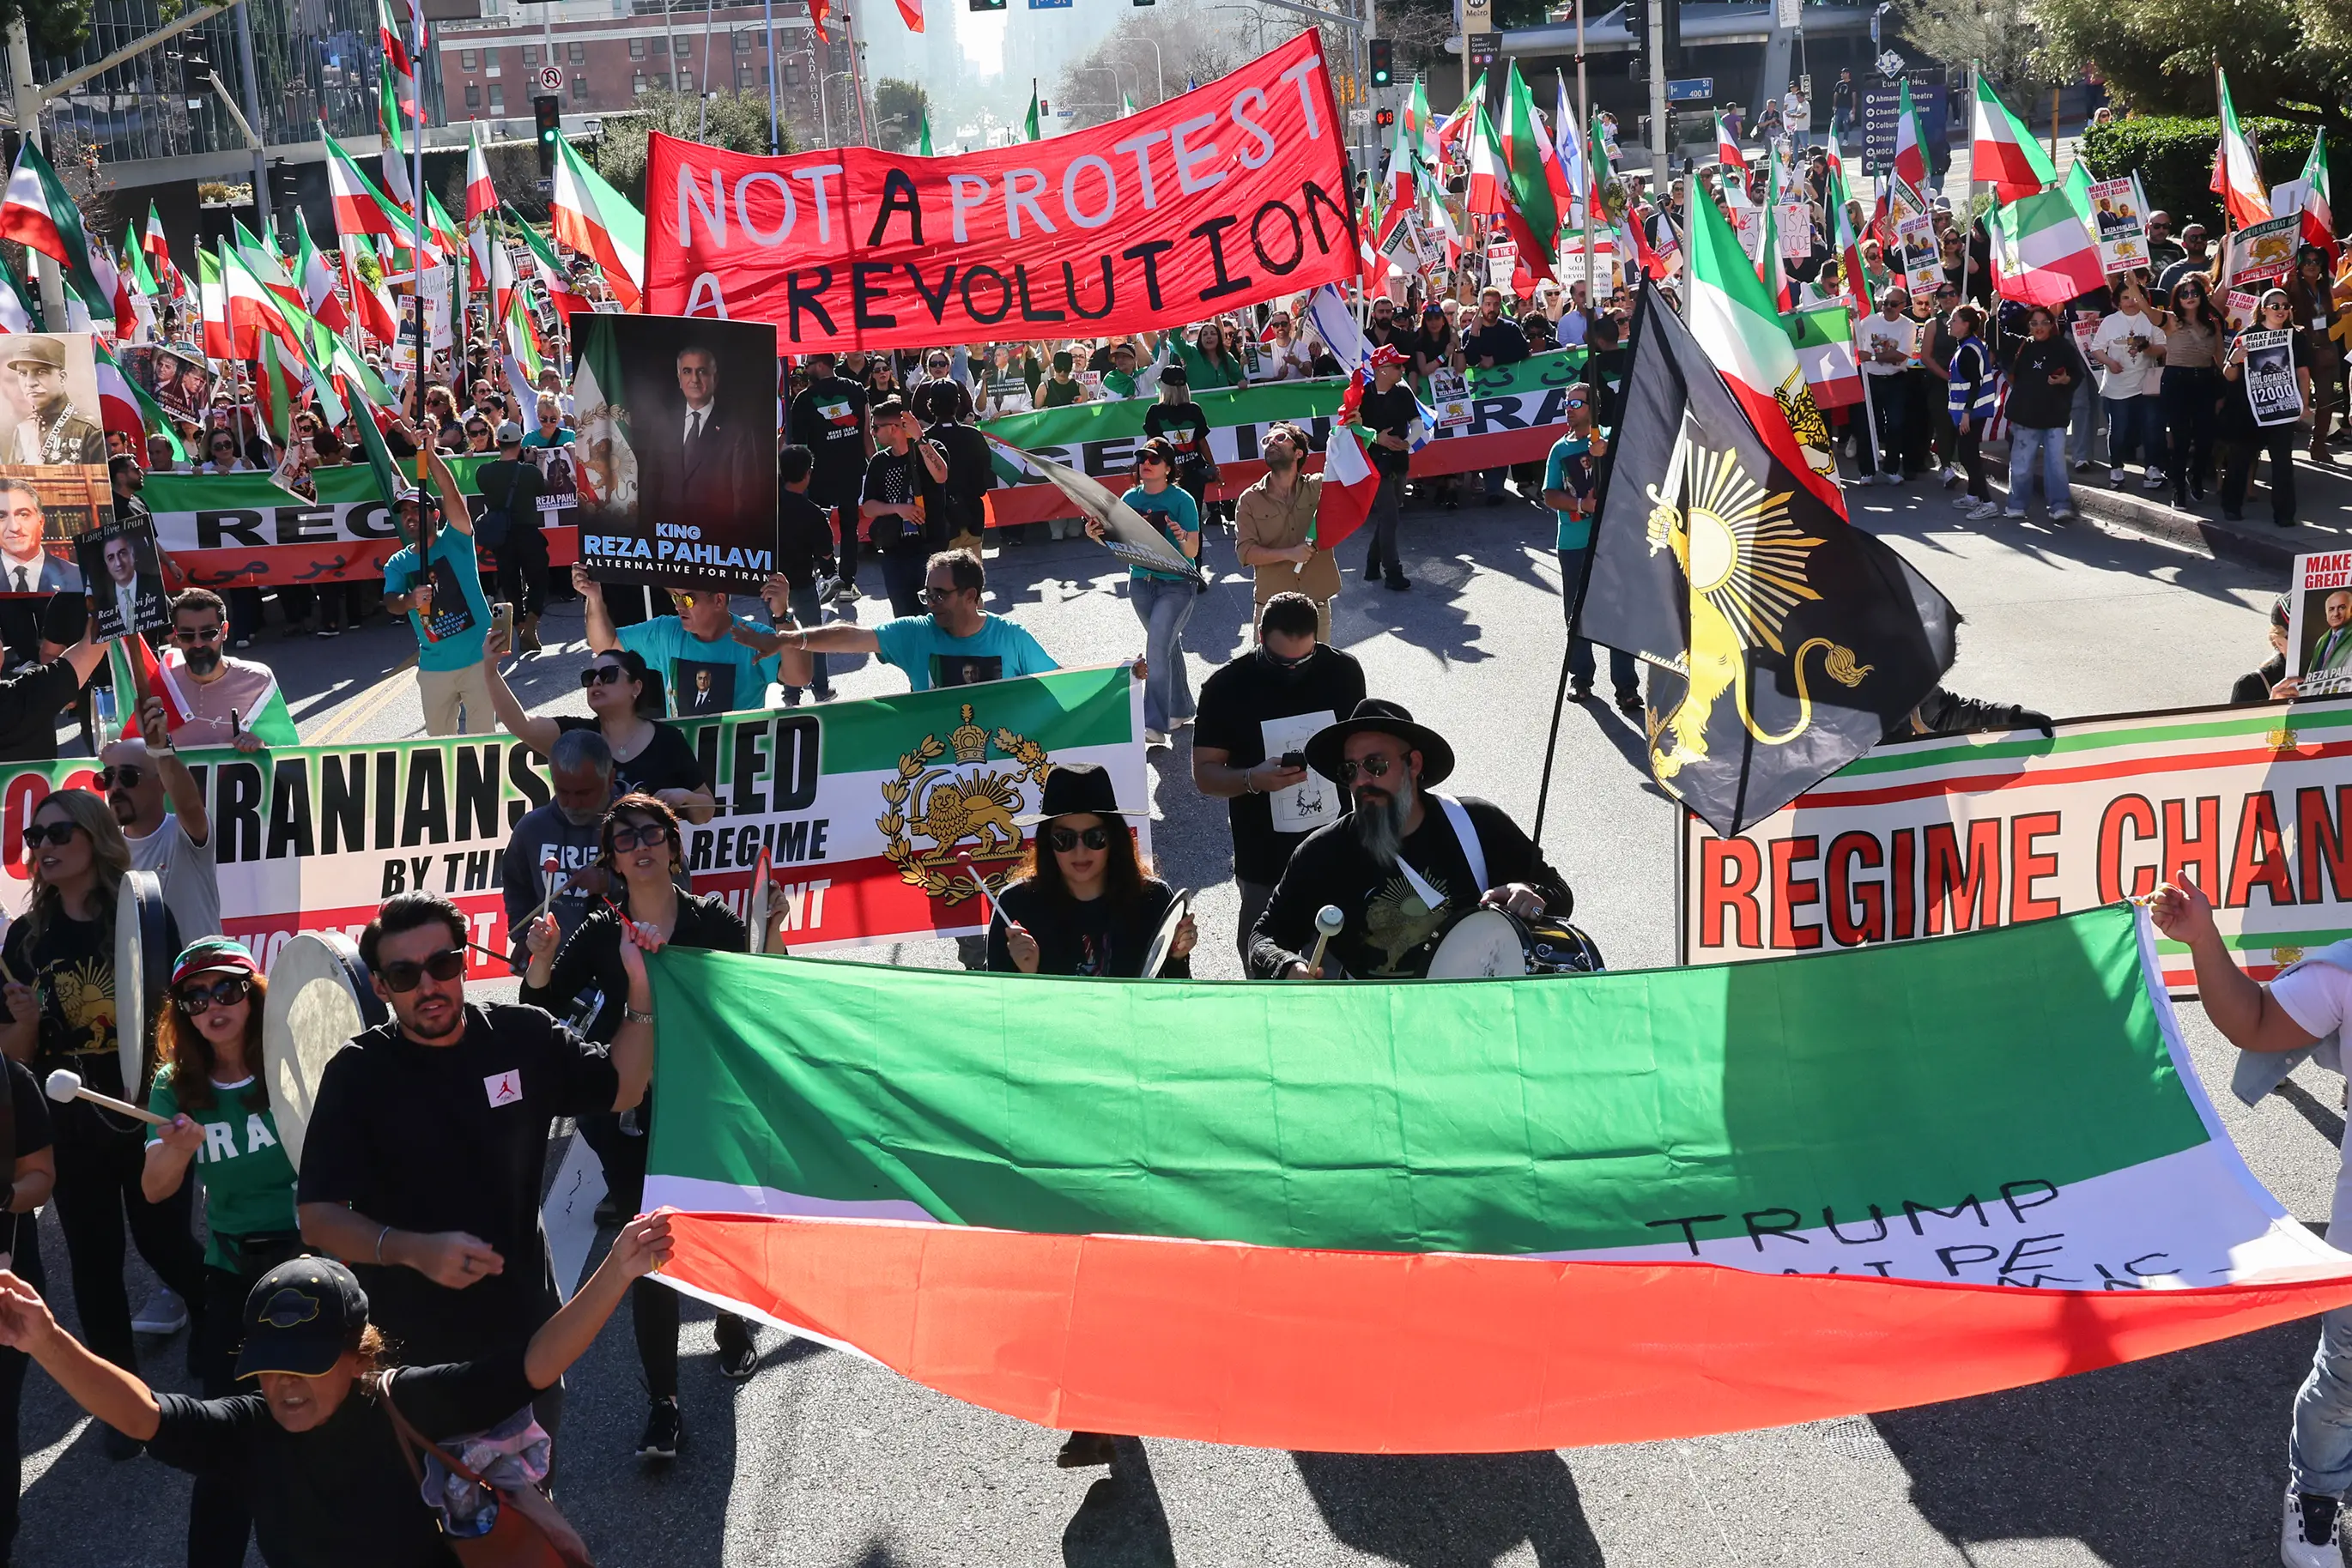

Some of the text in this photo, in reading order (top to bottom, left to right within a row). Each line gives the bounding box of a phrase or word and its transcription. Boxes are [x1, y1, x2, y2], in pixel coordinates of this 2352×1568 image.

[802, 27, 817, 82] KAWADA
[1702, 79, 1710, 88] St
[1689, 89, 1702, 98] 400
[678, 55, 1321, 248] NOT A PROTEST
[2088, 179, 2129, 194] MAKE IRAN
[2091, 186, 2131, 200] GREAT AGAIN
[1783, 212, 1797, 233] IS
[1799, 211, 1809, 232] A
[1900, 215, 1929, 228] MAKE IRAN
[1915, 221, 1929, 230] AGAIN
[2237, 219, 2286, 243] MAKE IRAN GREAT
[1491, 247, 1511, 257] TO THE
[1743, 233, 1809, 255] GOCIDE
[683, 181, 1356, 342] A REVOLUTION
[2240, 266, 2276, 282] Long live
[2238, 294, 2256, 304] IRAN
[2246, 330, 2288, 342] MAKE IRAN
[2246, 337, 2288, 349] GREAT AGAIN
[2251, 370, 2290, 385] HOLOCAUST
[2252, 384, 2294, 403] 12000
[843, 429, 859, 438] AGAIN
[536, 494, 556, 506] REZA
[82, 518, 144, 544] Long live Iran
[656, 523, 701, 540] KING
[585, 535, 772, 571] REZA PAHLAVI
[1105, 540, 1140, 556] REZA
[585, 558, 770, 582] ALTERNATIVE FOR IRAN
[2306, 554, 2351, 573] MAKE
[2305, 572, 2348, 590] GREAT
[98, 591, 157, 620] Reza for
[141, 607, 156, 619] and
[136, 623, 144, 633] in
[146, 618, 165, 629] Iran.
[444, 611, 468, 625] PAHLAVI
[2306, 669, 2329, 684] REZA
[381, 856, 433, 899] BY
[689, 818, 830, 871] REGIME
[1700, 783, 2352, 950] REGIME CHAN
[1645, 1178, 2059, 1257] TRUMP
